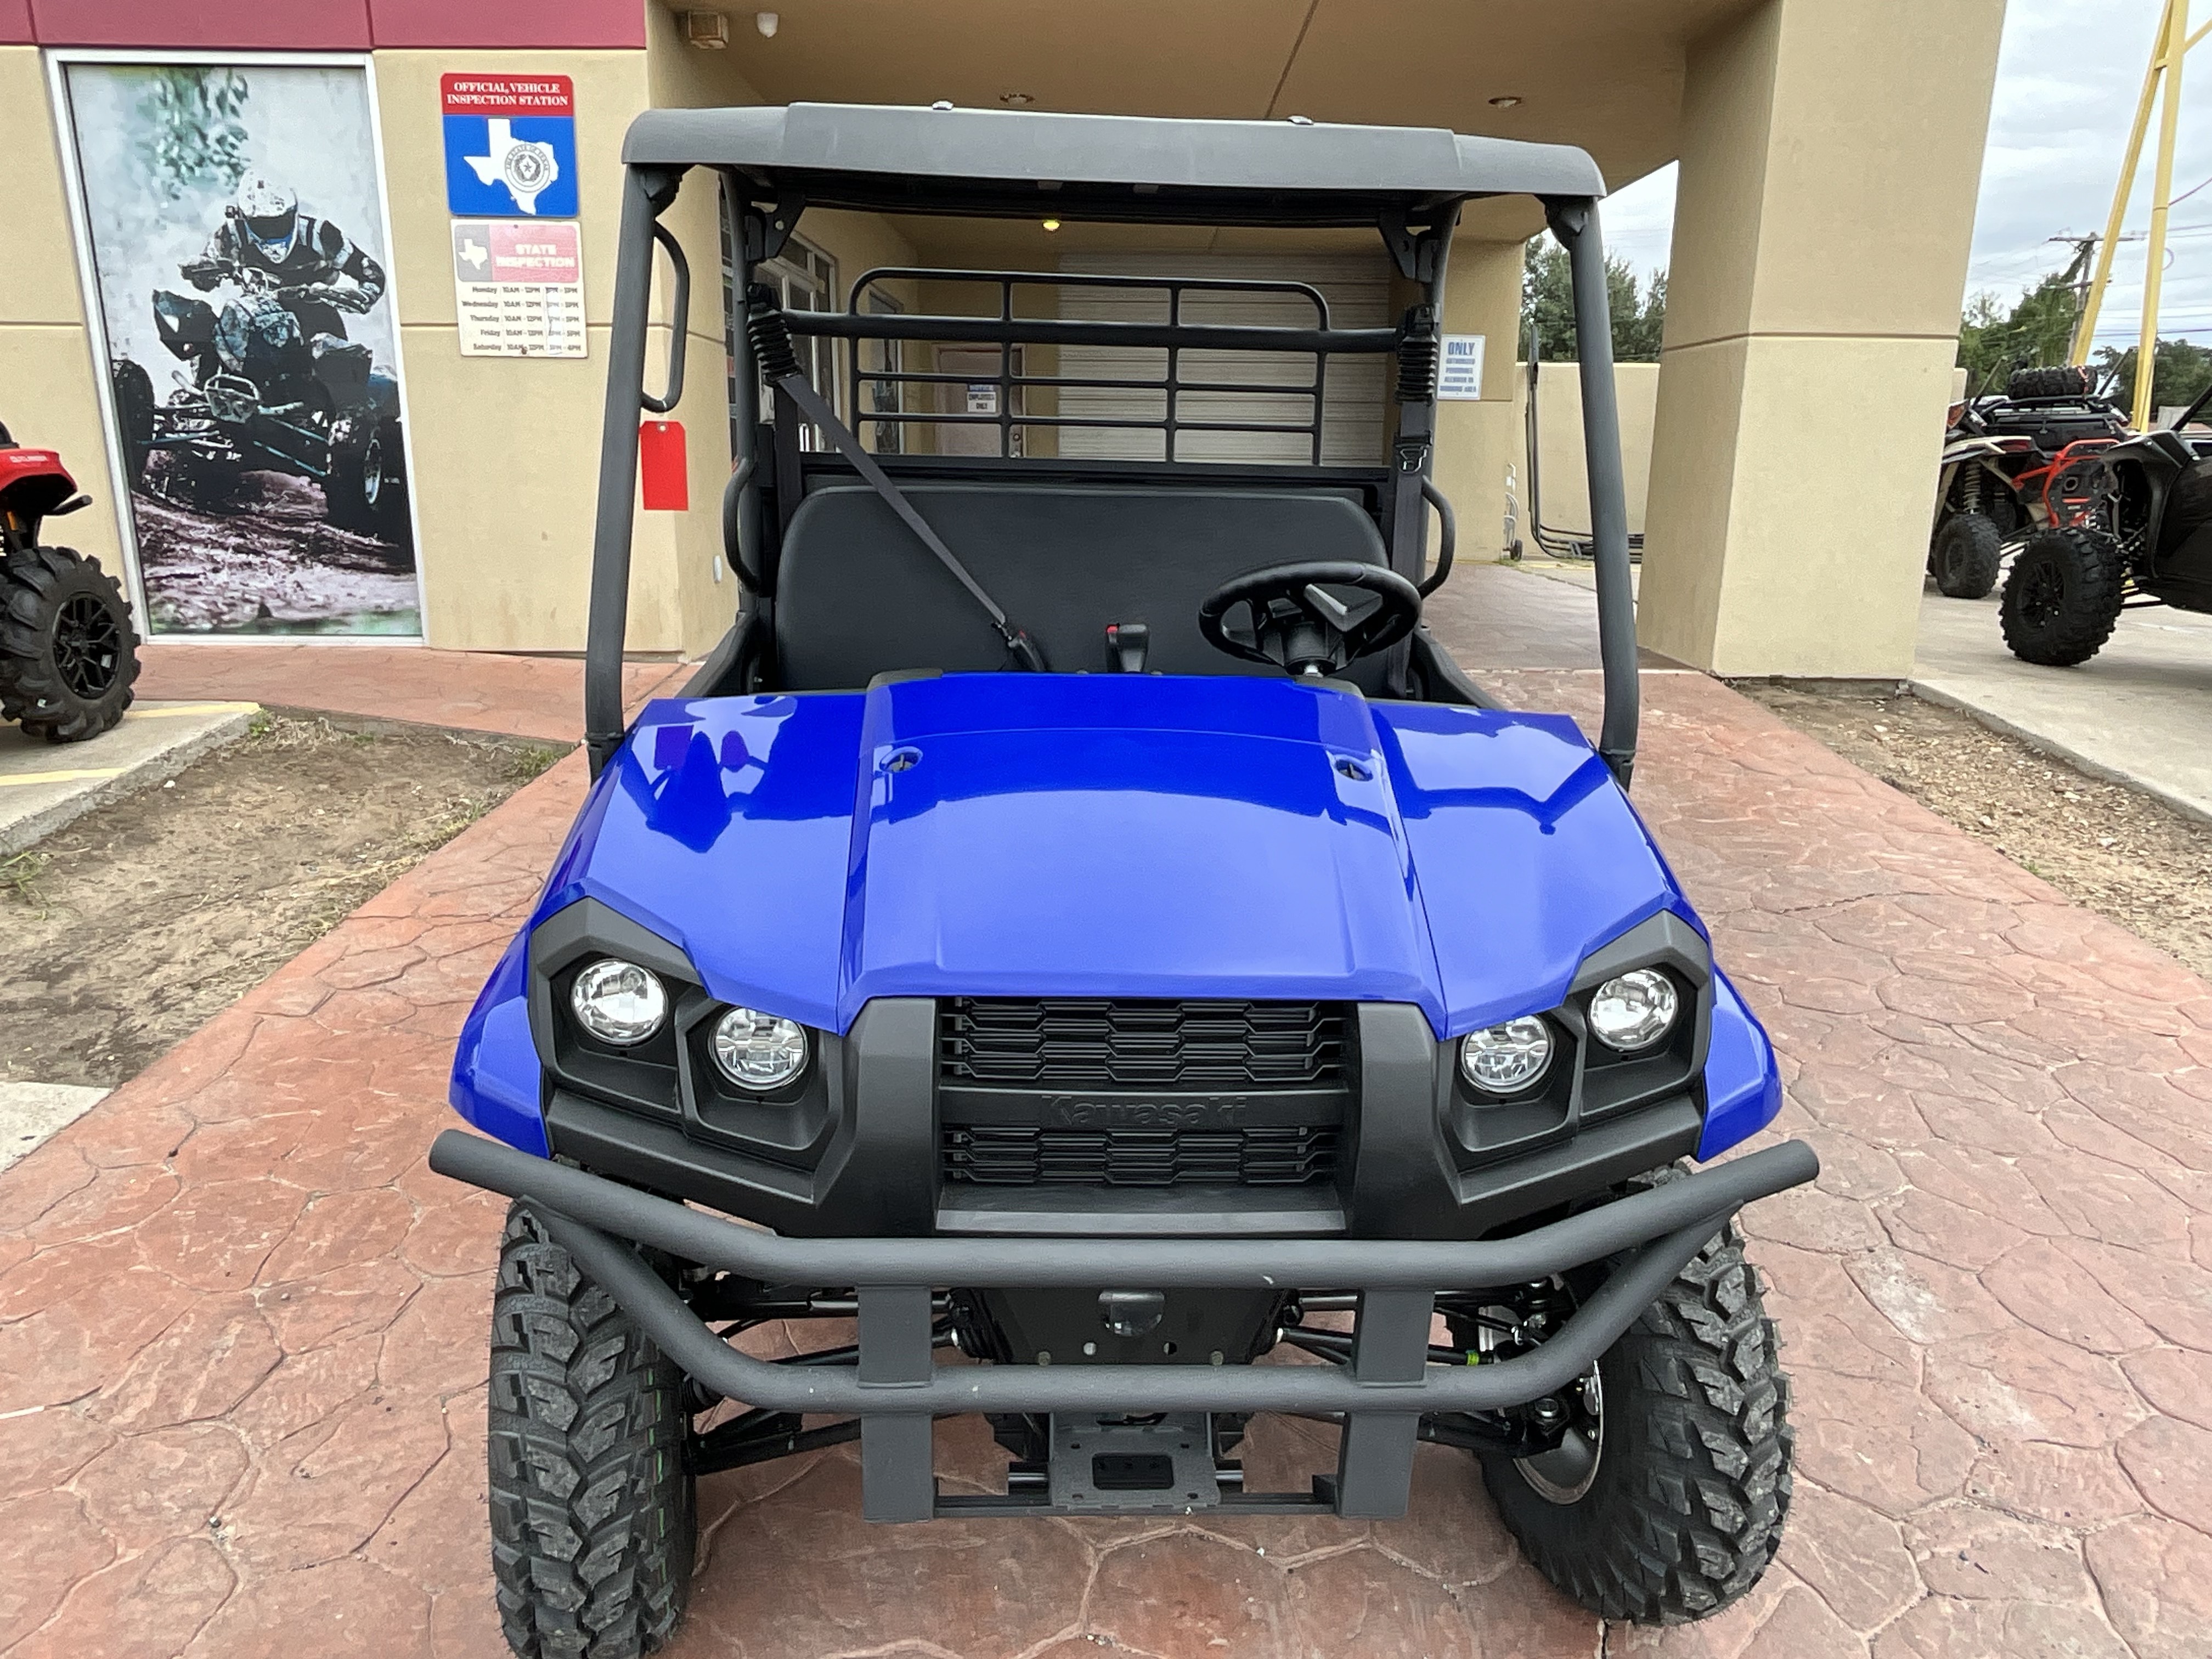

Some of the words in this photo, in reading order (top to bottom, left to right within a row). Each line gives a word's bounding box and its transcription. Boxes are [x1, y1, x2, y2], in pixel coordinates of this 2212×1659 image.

[454, 82, 508, 93] OFFICIAL
[510, 83, 560, 94] VEHICLE
[447, 94, 517, 105] INSPECTION
[518, 95, 568, 106] STATION
[515, 244, 557, 255] STATE
[495, 256, 575, 268] INSPECTION
[1448, 342, 1475, 356] ONLY
